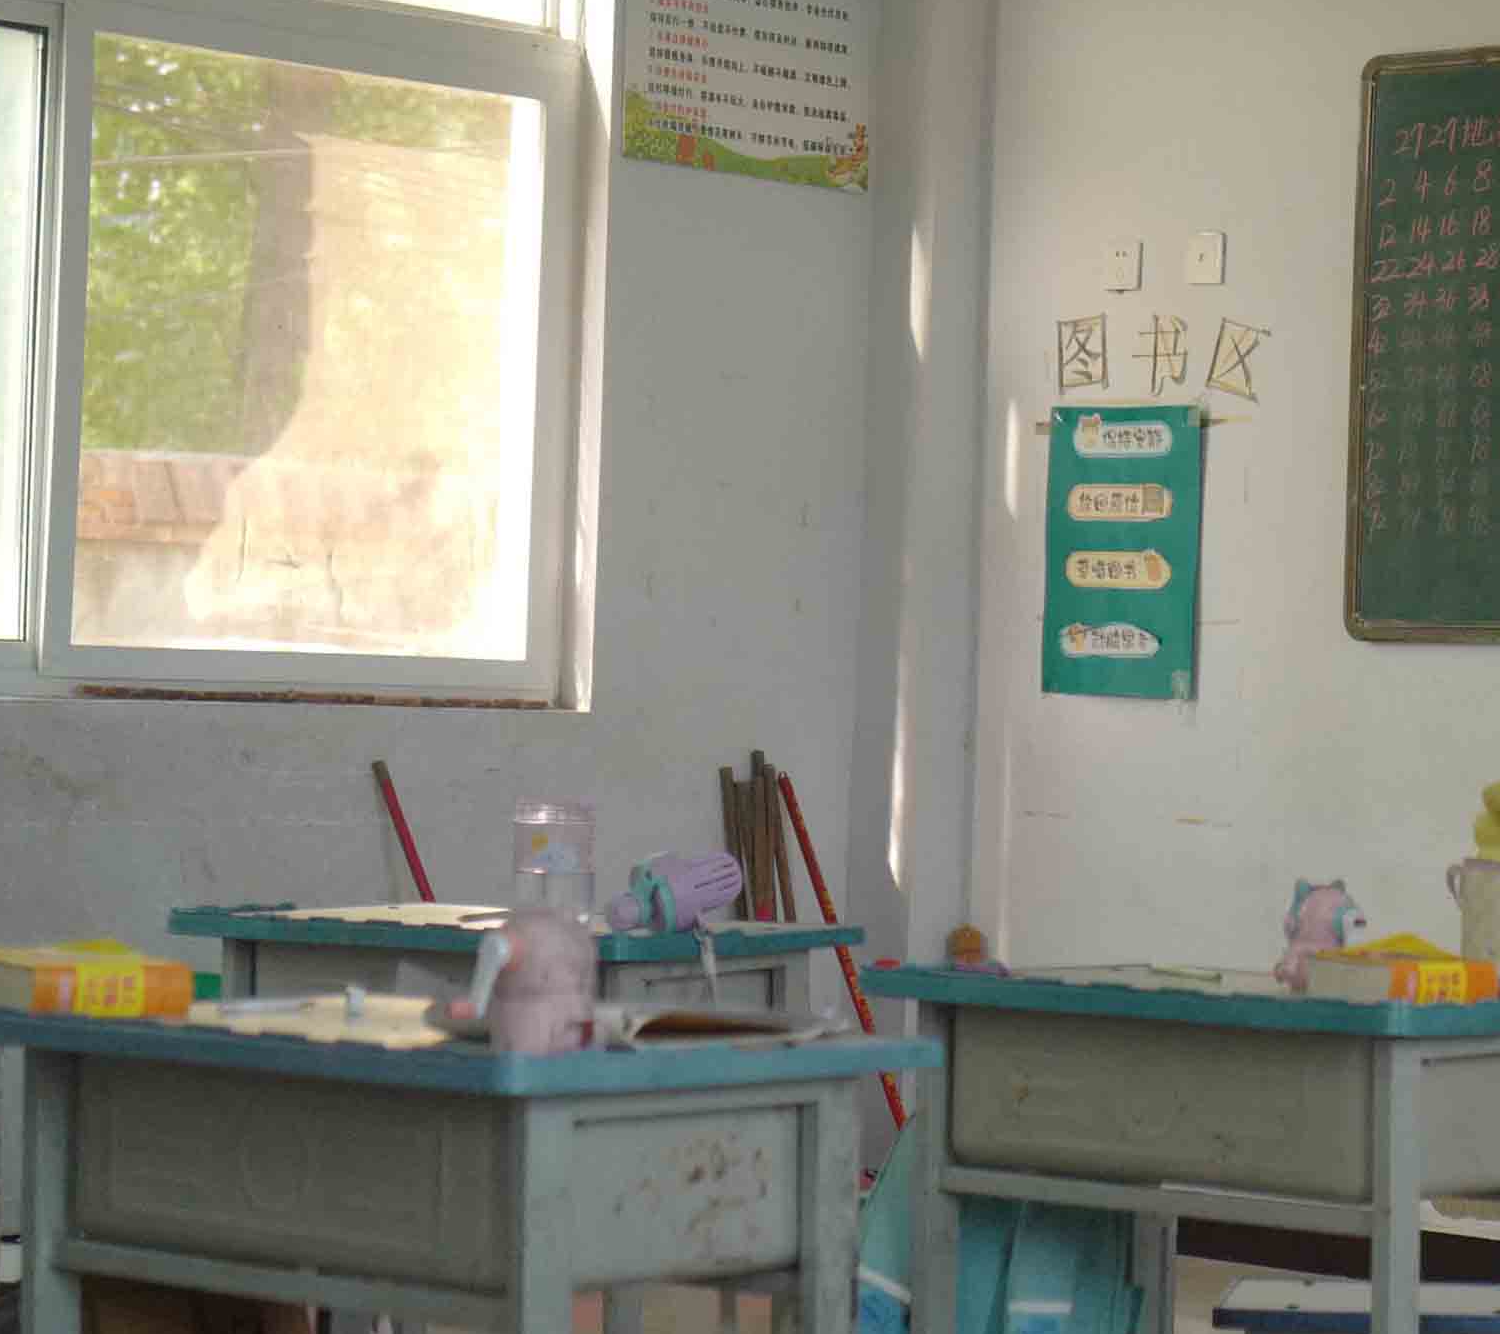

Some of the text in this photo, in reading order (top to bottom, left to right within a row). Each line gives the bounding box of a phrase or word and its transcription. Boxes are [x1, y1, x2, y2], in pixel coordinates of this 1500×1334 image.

[1378, 178, 1396, 207] 2
[1057, 313, 1271, 403] 图书区
